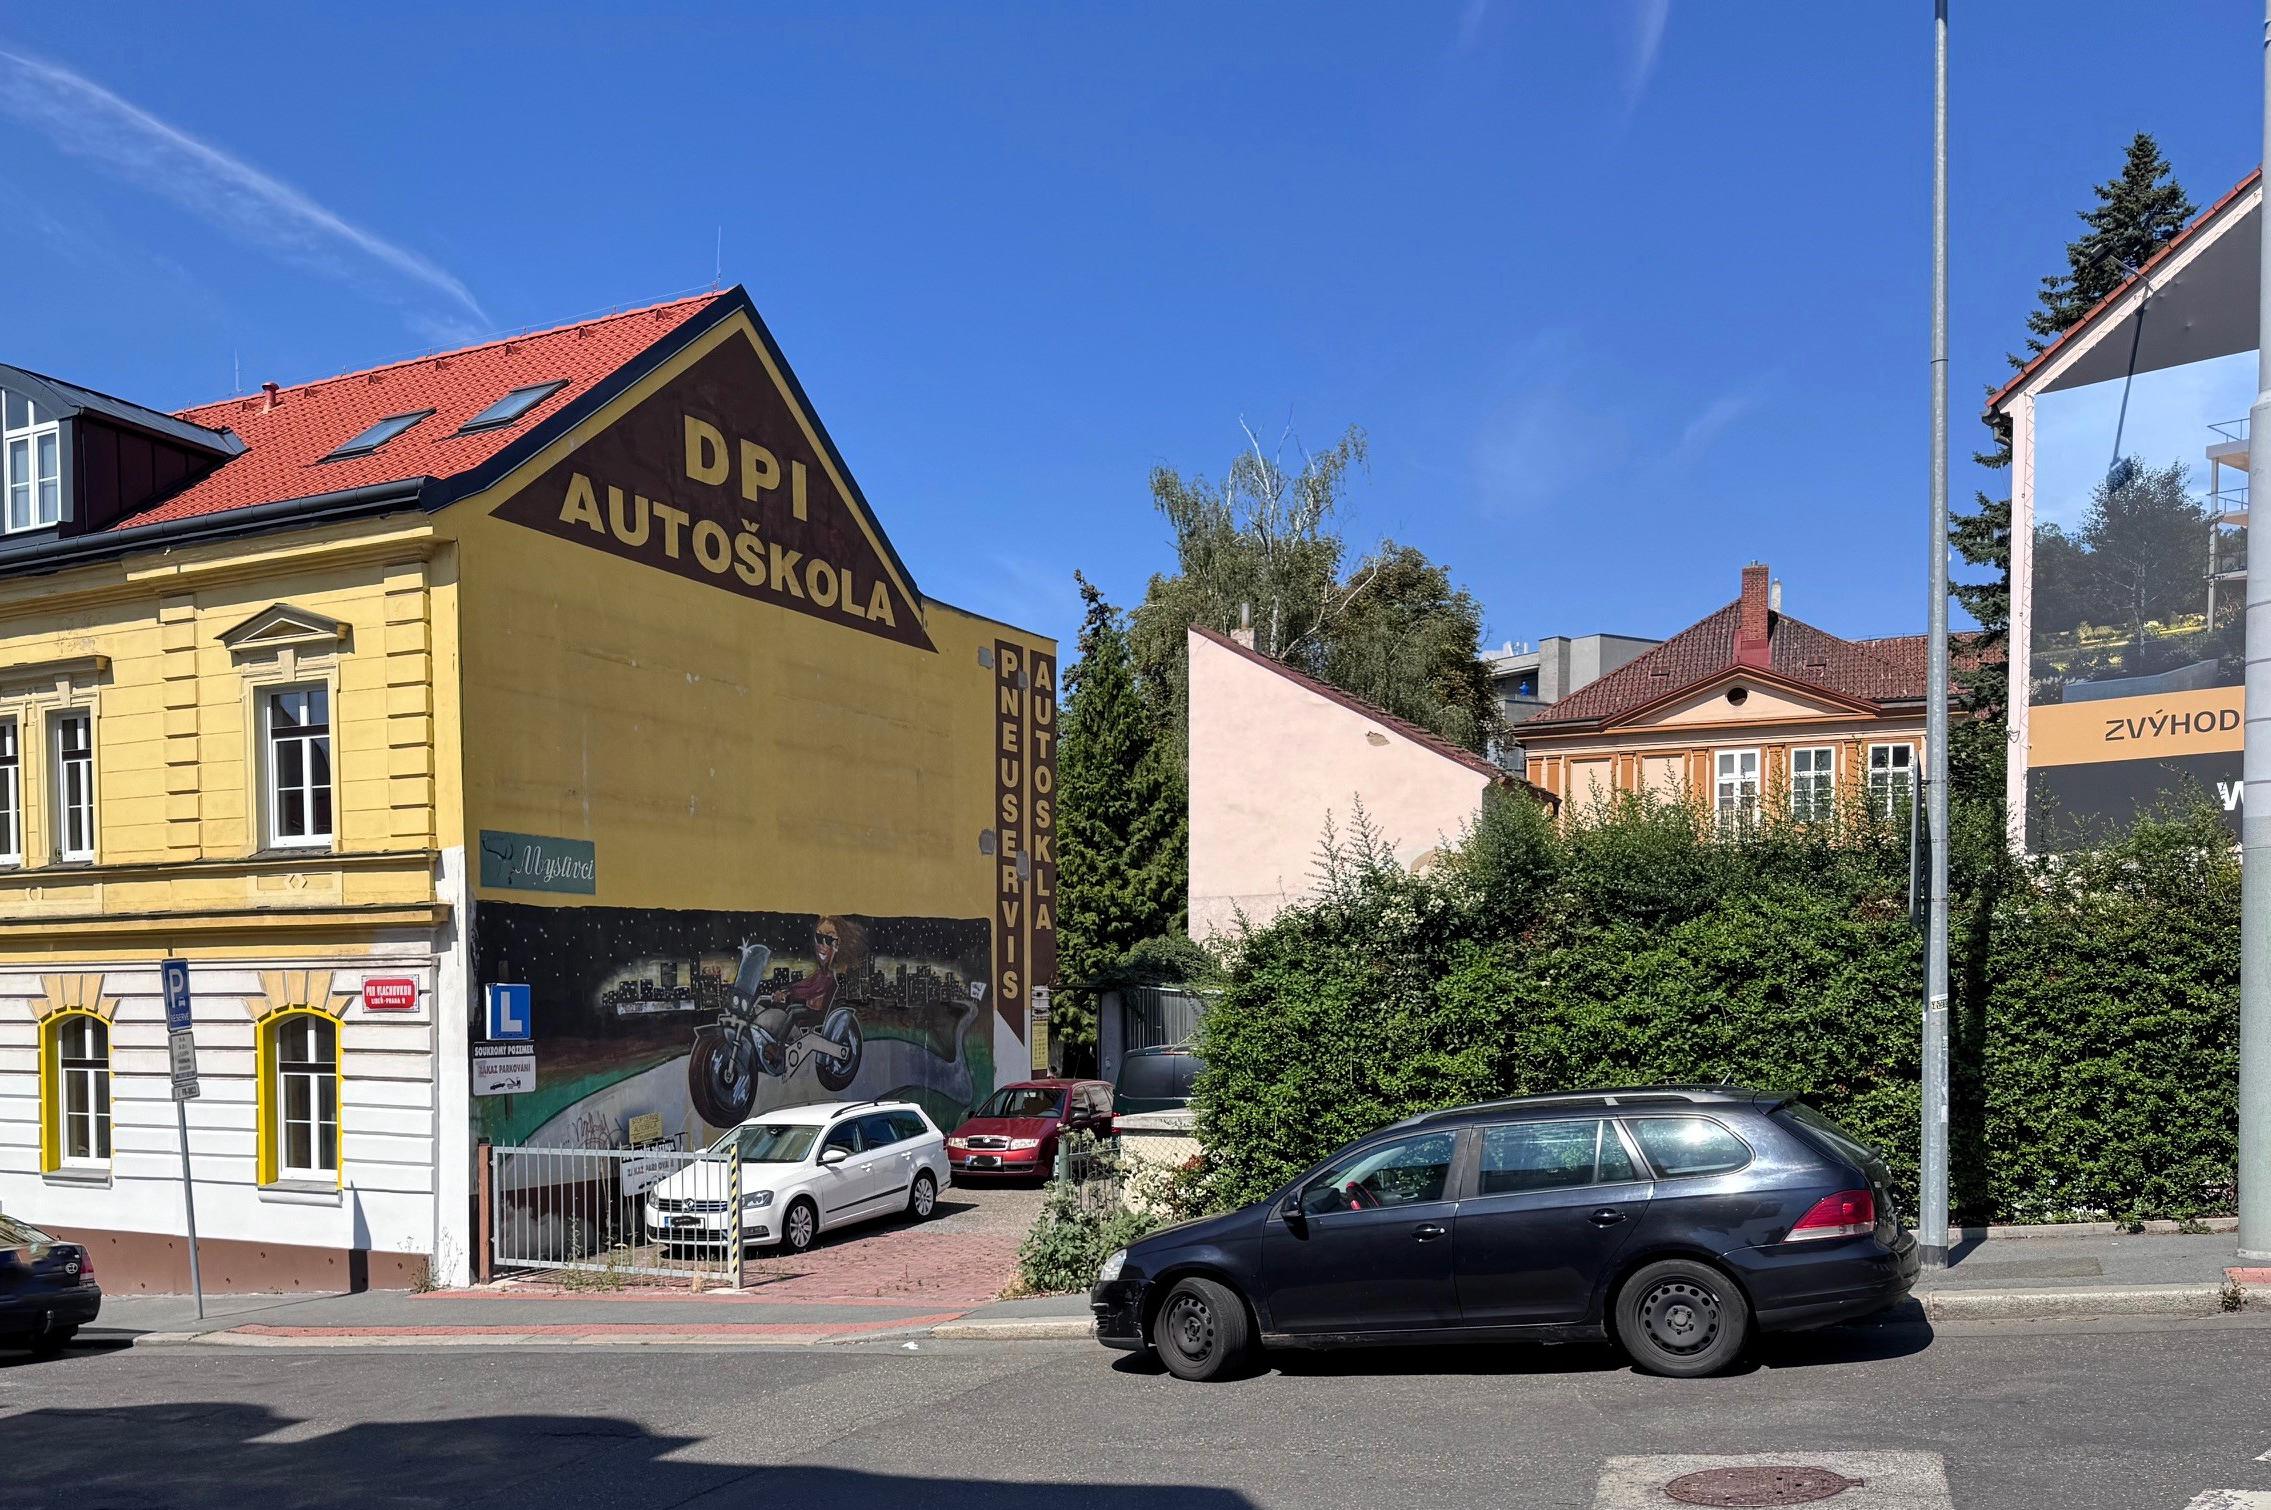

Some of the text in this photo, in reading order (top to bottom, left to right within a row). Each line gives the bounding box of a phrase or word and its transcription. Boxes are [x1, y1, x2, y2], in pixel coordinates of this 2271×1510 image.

[685, 415, 807, 522] DPI
[559, 472, 896, 628] AUTOŠKOLA
[2105, 708, 2240, 741] ZVÝHOD
[1001, 648, 1019, 999] PNEUSERVIS
[1034, 660, 1052, 930] AUTOSKLA
[168, 968, 184, 1009] P
[501, 991, 523, 1032] L
[474, 1043, 534, 1057] SOUKROMÝ POZEMEK
